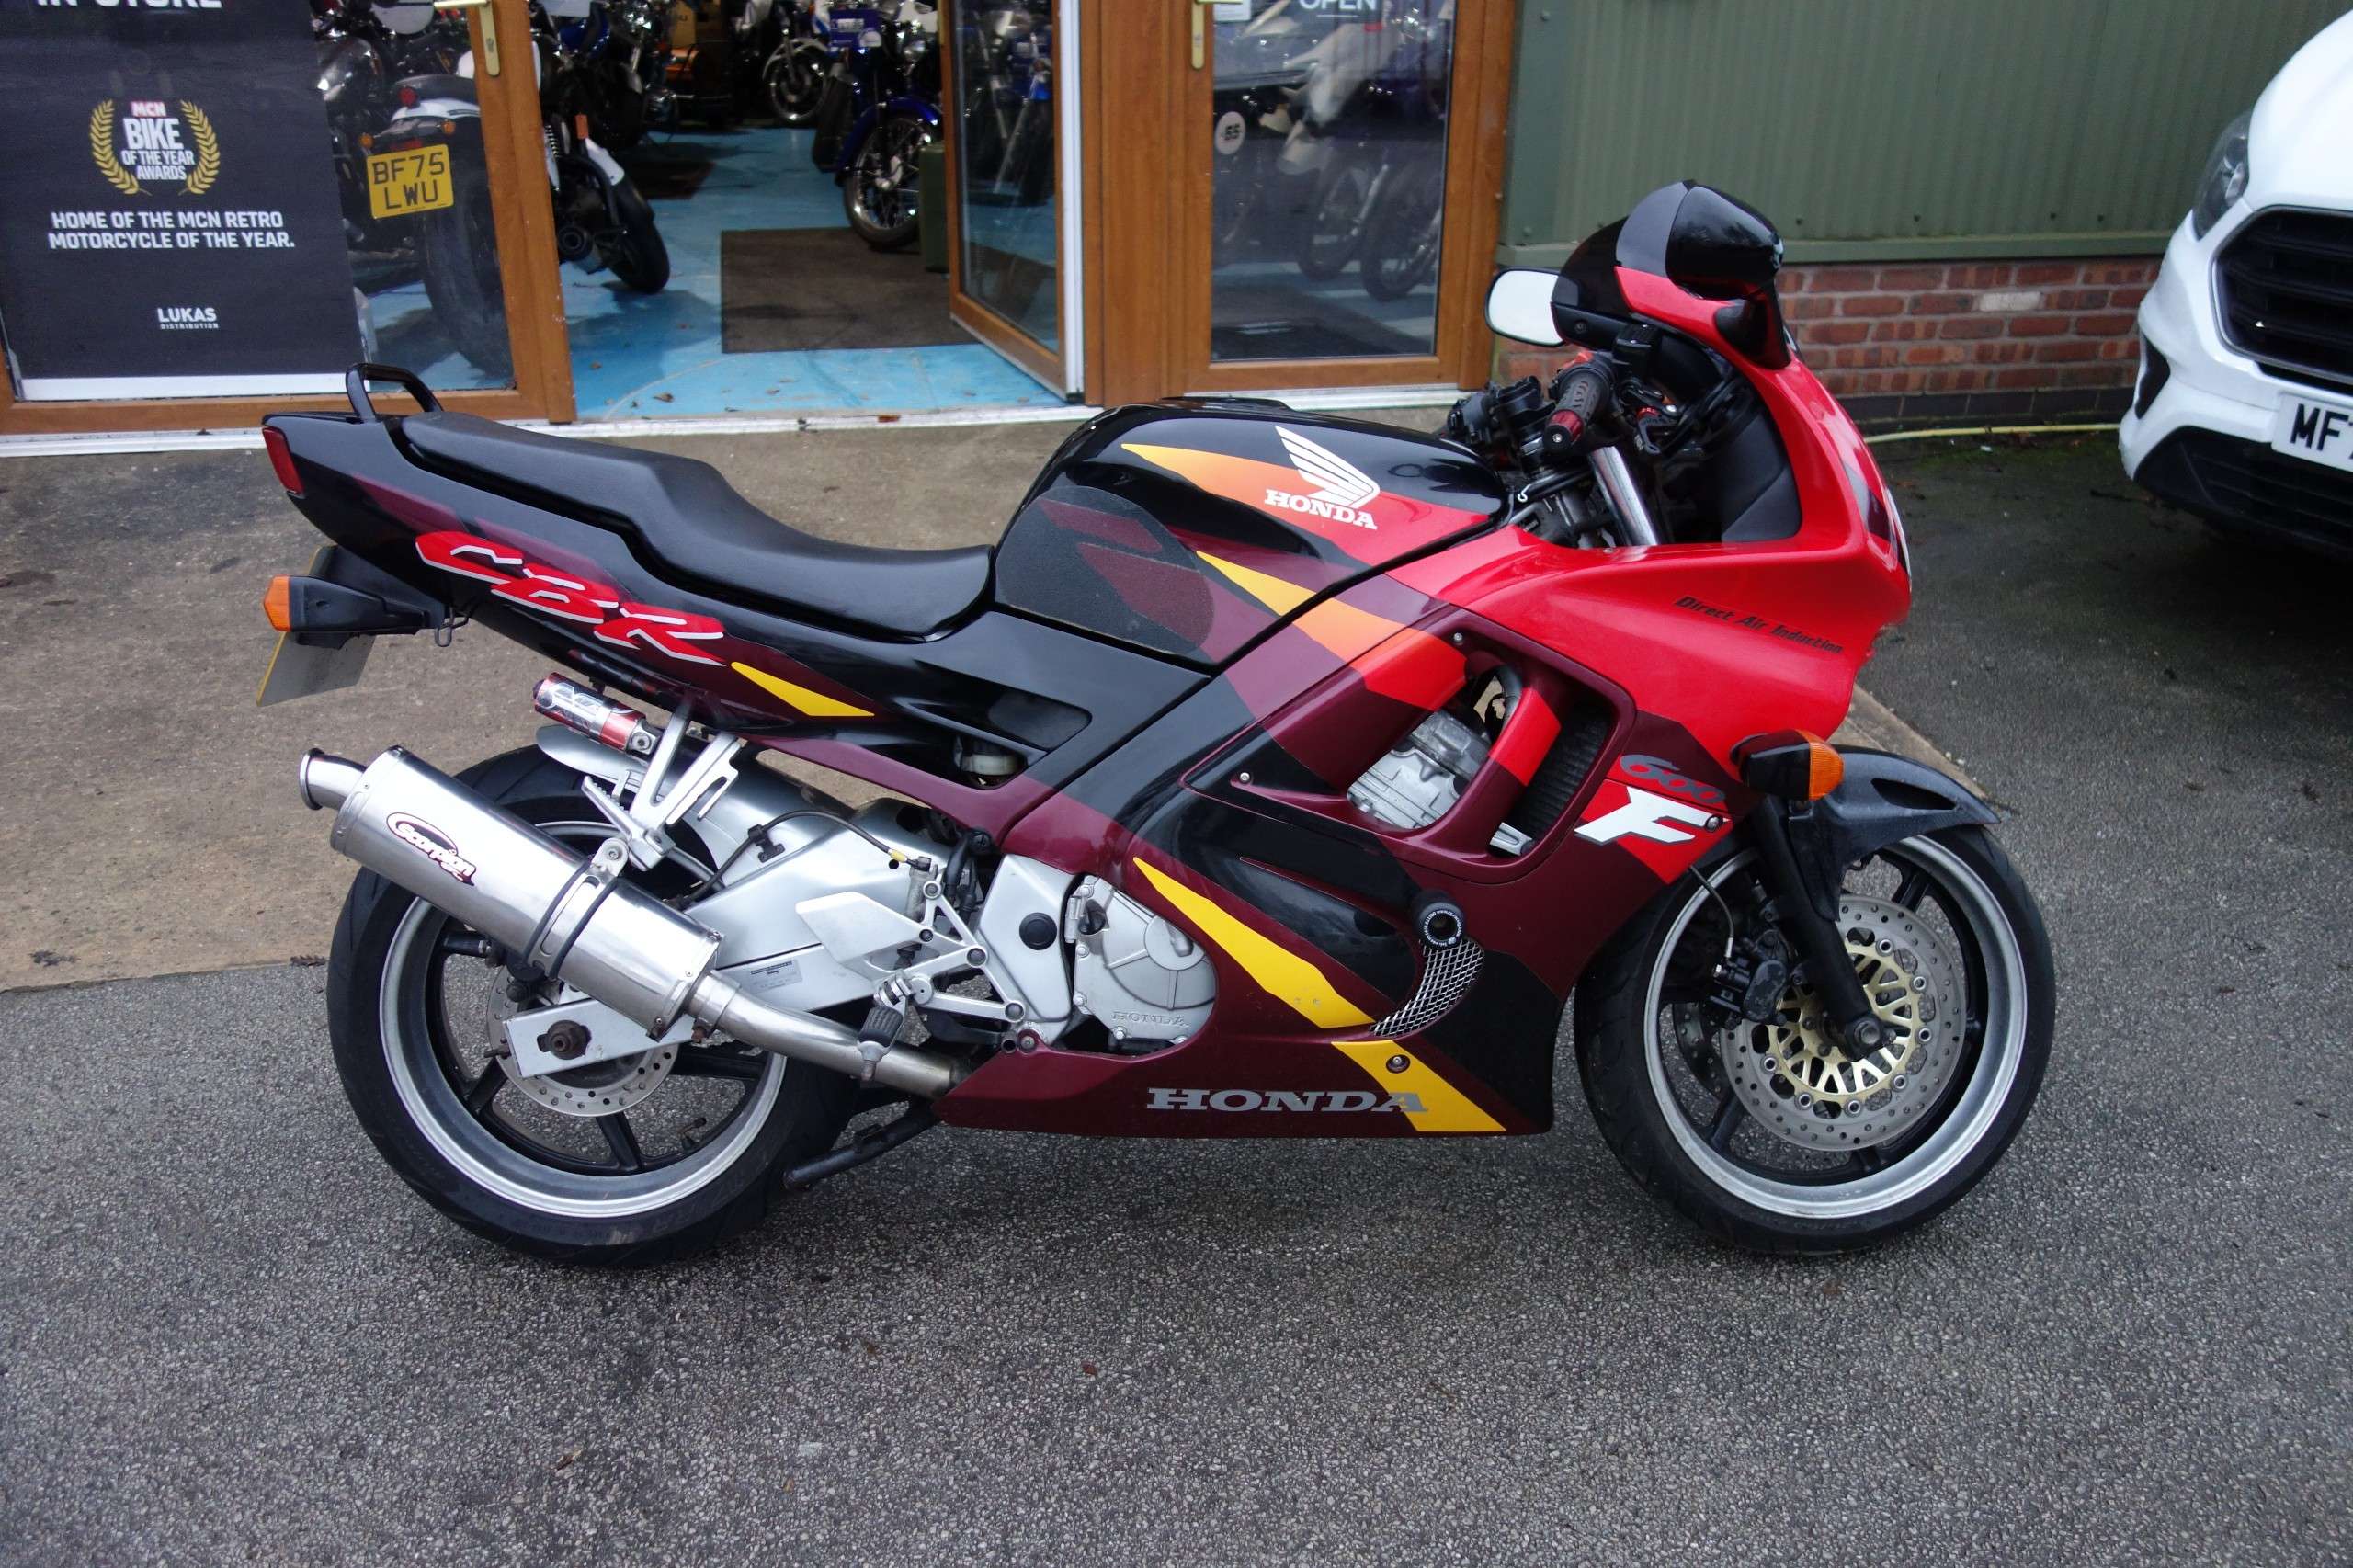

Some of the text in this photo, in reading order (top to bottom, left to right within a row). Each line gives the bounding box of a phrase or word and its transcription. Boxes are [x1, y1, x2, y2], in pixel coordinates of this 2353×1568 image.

[131, 101, 166, 117] MCN
[122, 118, 185, 150] BIKE
[120, 150, 196, 165] OF THE YEAR
[372, 152, 445, 184] BF75
[136, 165, 188, 180] AWARDS
[384, 179, 438, 210] LWU
[51, 211, 283, 229] HOME OF THE MCN RETRO
[48, 232, 295, 249] MOTORCYCLE OF THE YEAR.
[157, 307, 217, 323] LUKAS
[2290, 403, 2353, 460] MF
[1264, 489, 1378, 530] HONDA
[415, 531, 726, 666] CBR
[1675, 596, 1843, 653] Direct Air Induction
[1620, 754, 1727, 804] 600
[1110, 1010, 1192, 1028] HONDA
[1146, 1087, 1428, 1113] HONDA
